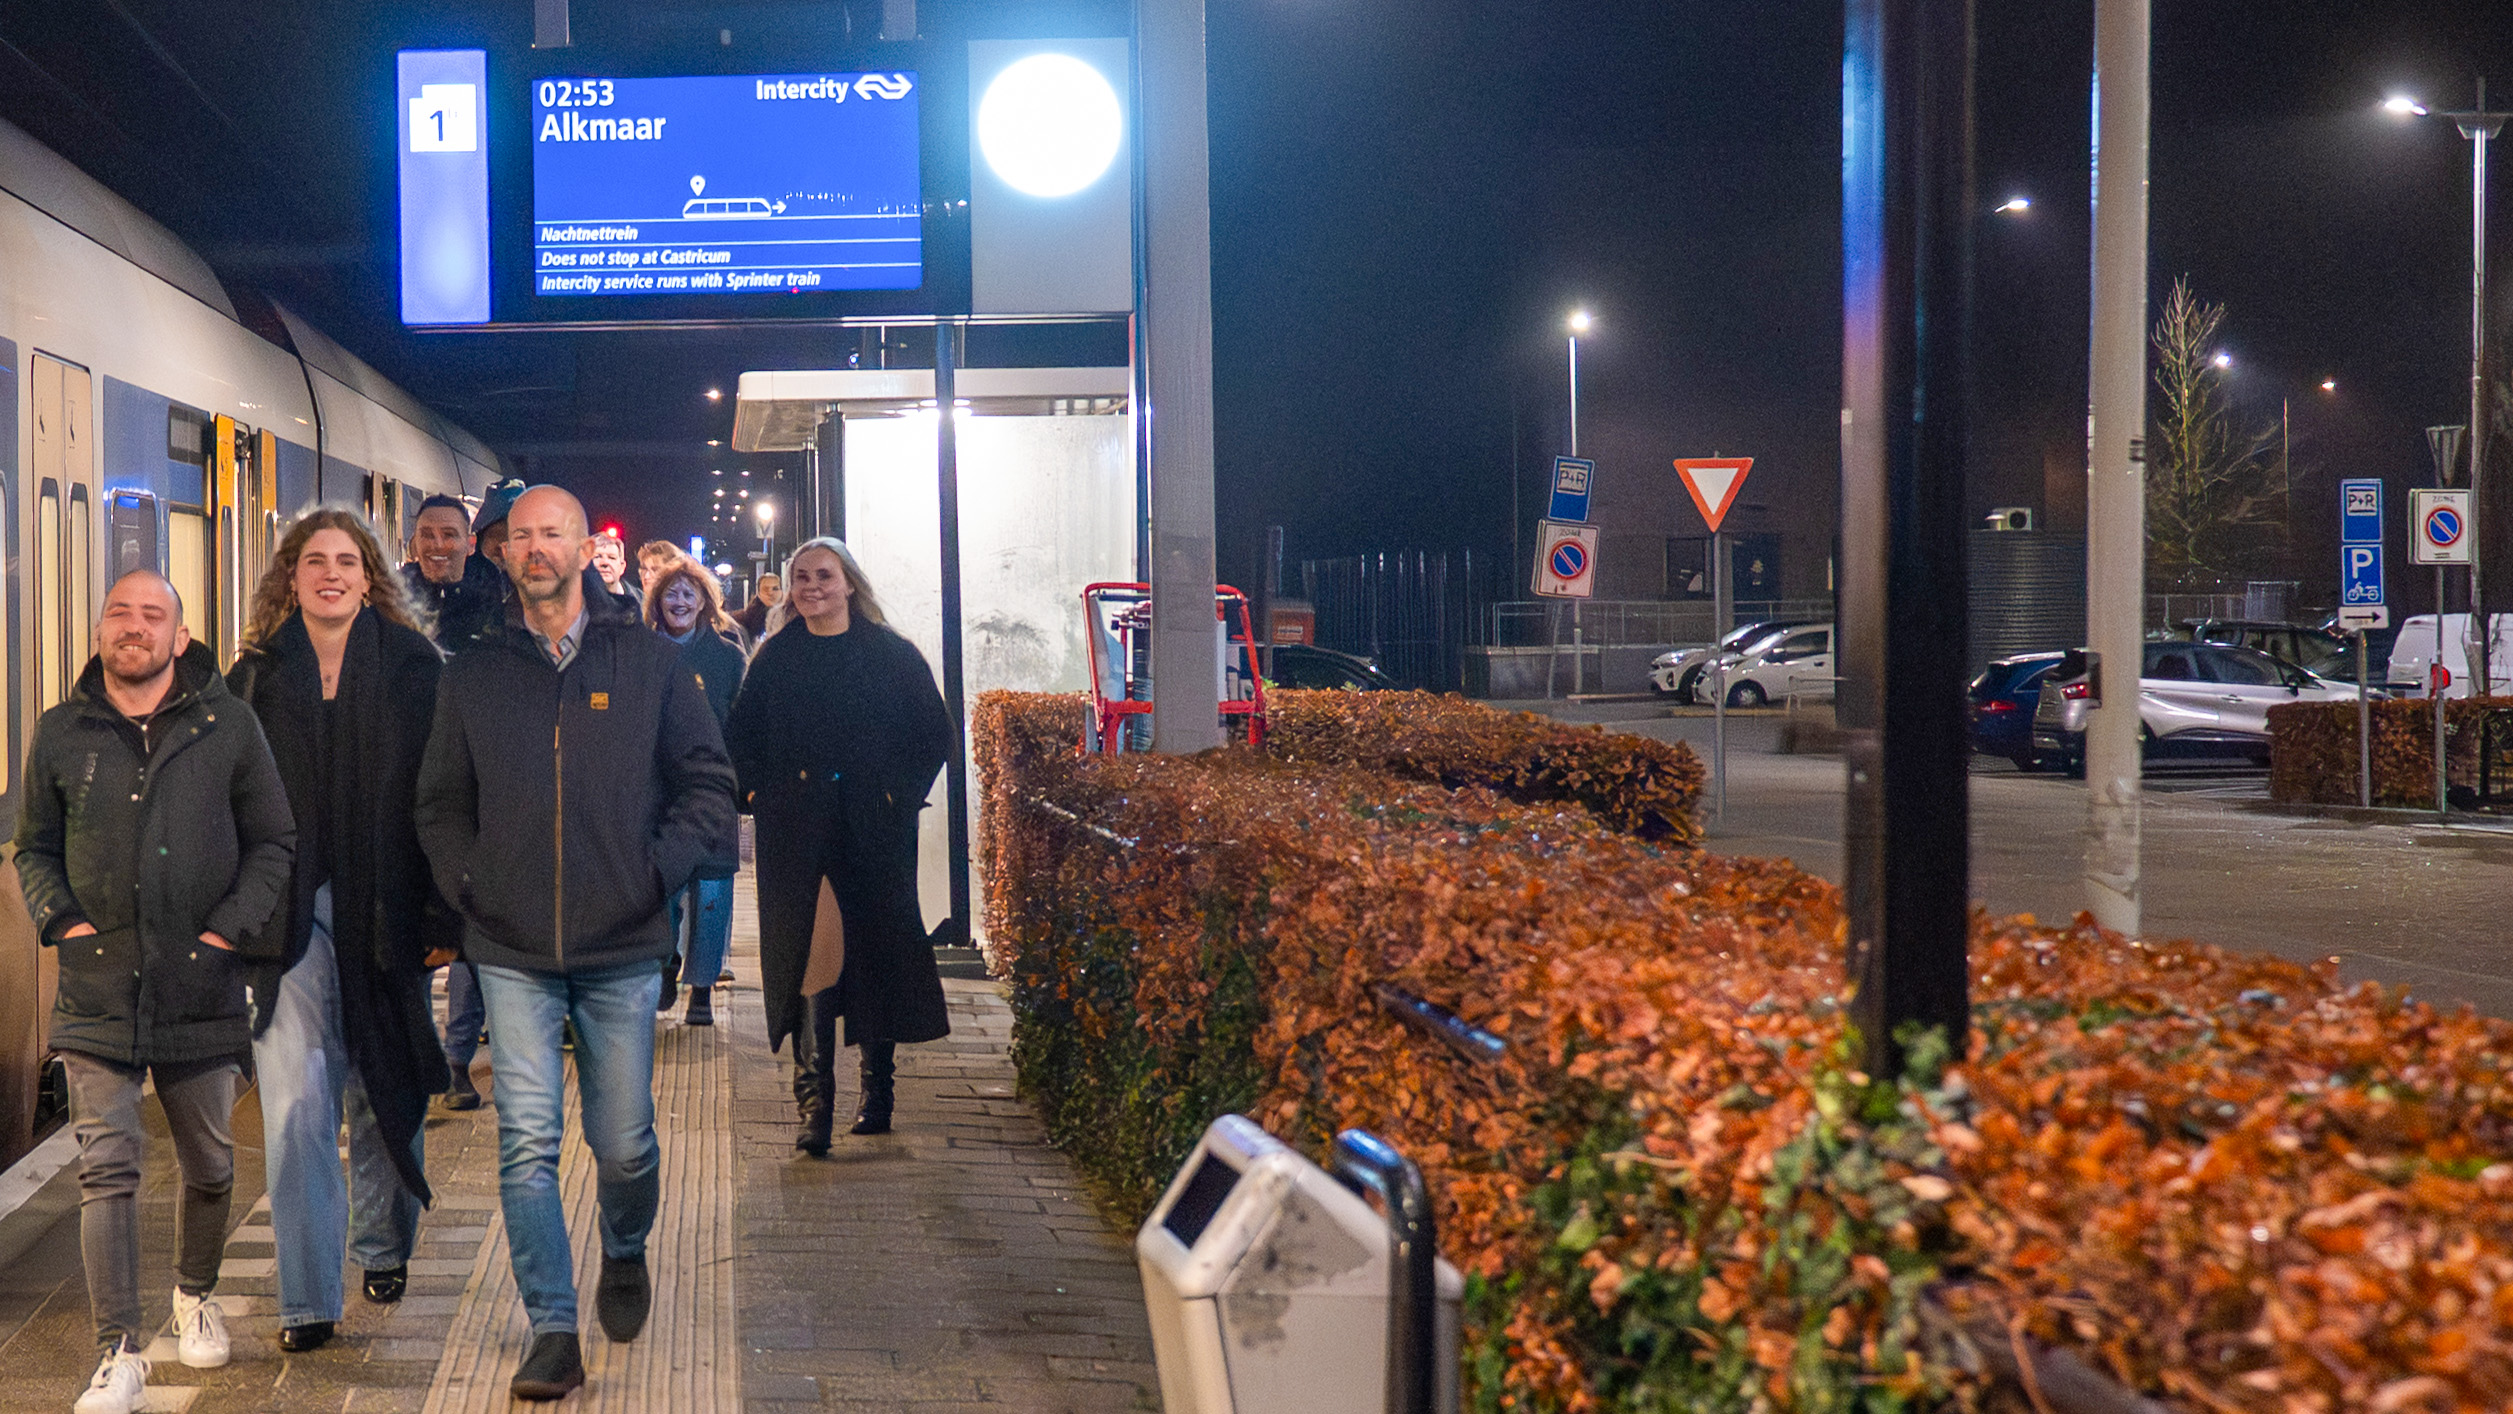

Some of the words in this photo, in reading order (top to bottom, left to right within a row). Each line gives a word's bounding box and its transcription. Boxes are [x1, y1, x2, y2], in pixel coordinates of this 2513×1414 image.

[539, 80, 615, 107] 02:53
[756, 77, 849, 104] Intercity
[539, 111, 667, 142] Alkmaar
[541, 225, 638, 242] Nachtnettrein
[541, 251, 577, 267] Does
[580, 251, 606, 266] not
[607, 251, 639, 268] stop
[641, 250, 659, 265] at
[660, 248, 731, 265] Castricum
[542, 274, 602, 294] Intercity
[603, 274, 653, 289] service
[656, 275, 688, 289] runs
[690, 272, 723, 288] with
[725, 272, 784, 291] Sprinter
[786, 271, 821, 287] train
[1558, 469, 1586, 488] P+R
[2348, 494, 2375, 508] P+R
[2351, 548, 2374, 579] P
